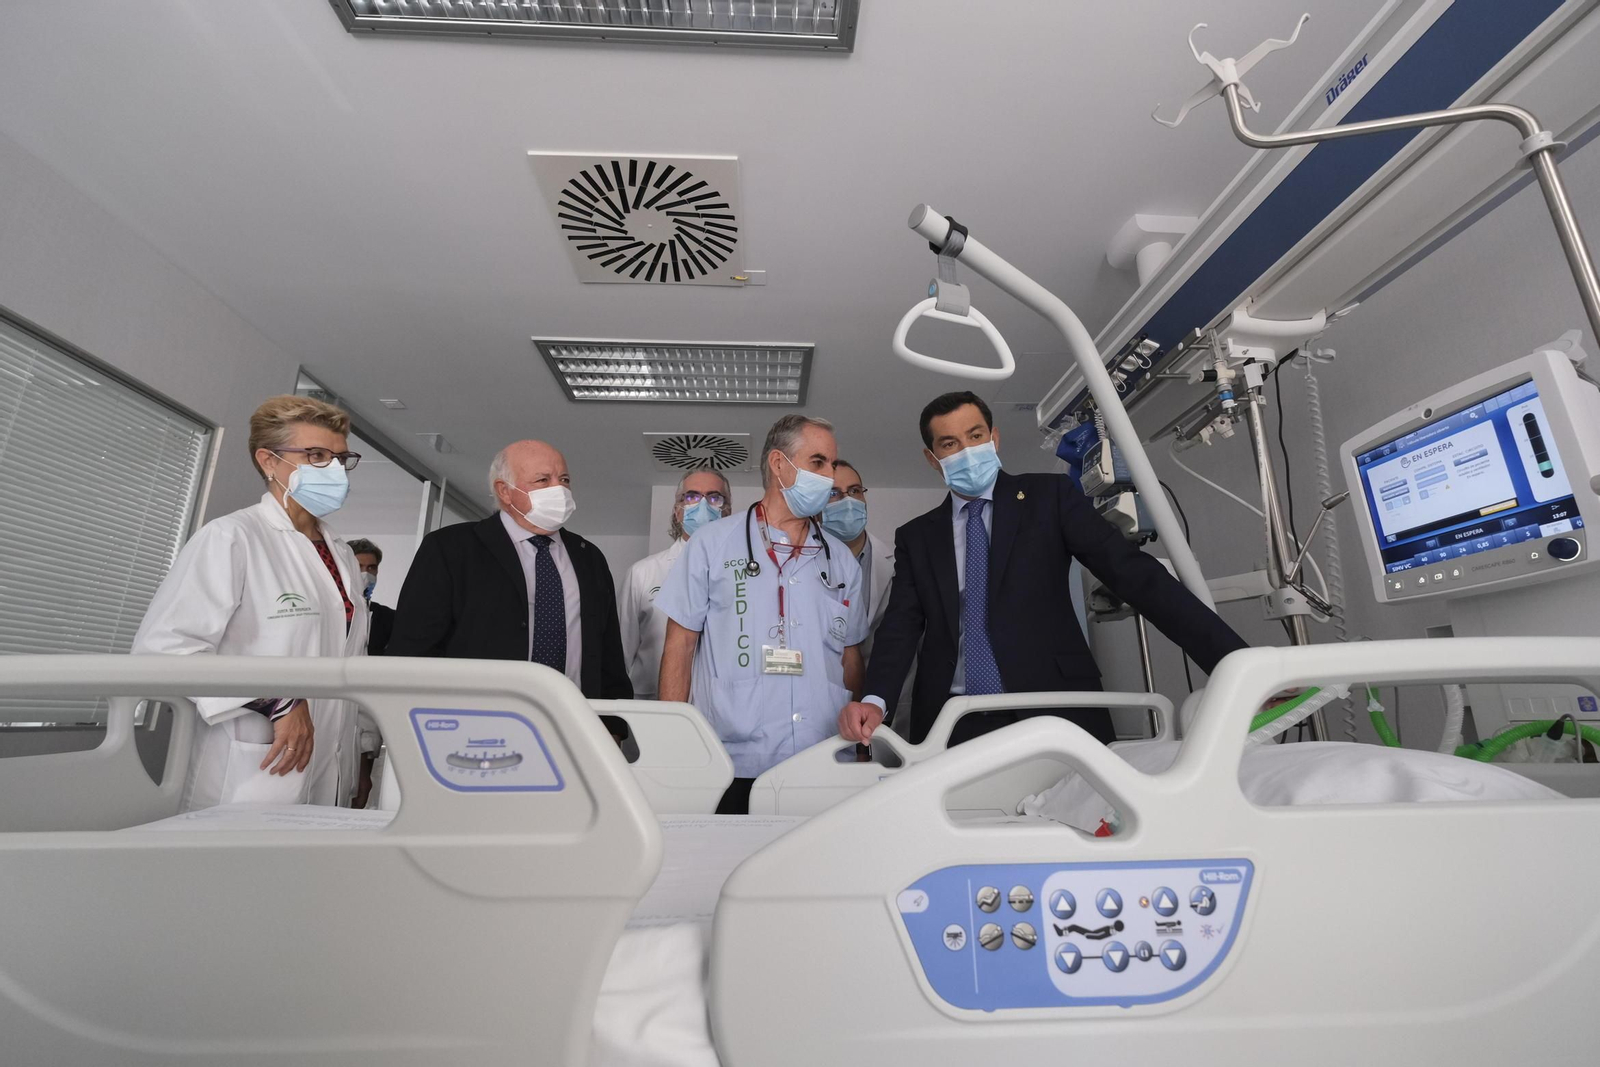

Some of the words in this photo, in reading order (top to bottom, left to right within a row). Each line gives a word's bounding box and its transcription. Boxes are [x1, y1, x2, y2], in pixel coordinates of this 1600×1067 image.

[1325, 53, 1368, 106] Dräger
[1411, 453, 1423, 463] EN
[1423, 441, 1454, 458] ESPERA
[1552, 511, 1567, 519] 13:07
[1463, 528, 1484, 538] ESPERA
[1477, 541, 1490, 549] 0,85
[734, 568, 750, 668] MEDICO
[427, 721, 457, 729] Hill-Rom
[1203, 871, 1239, 881] Hill-Rom
